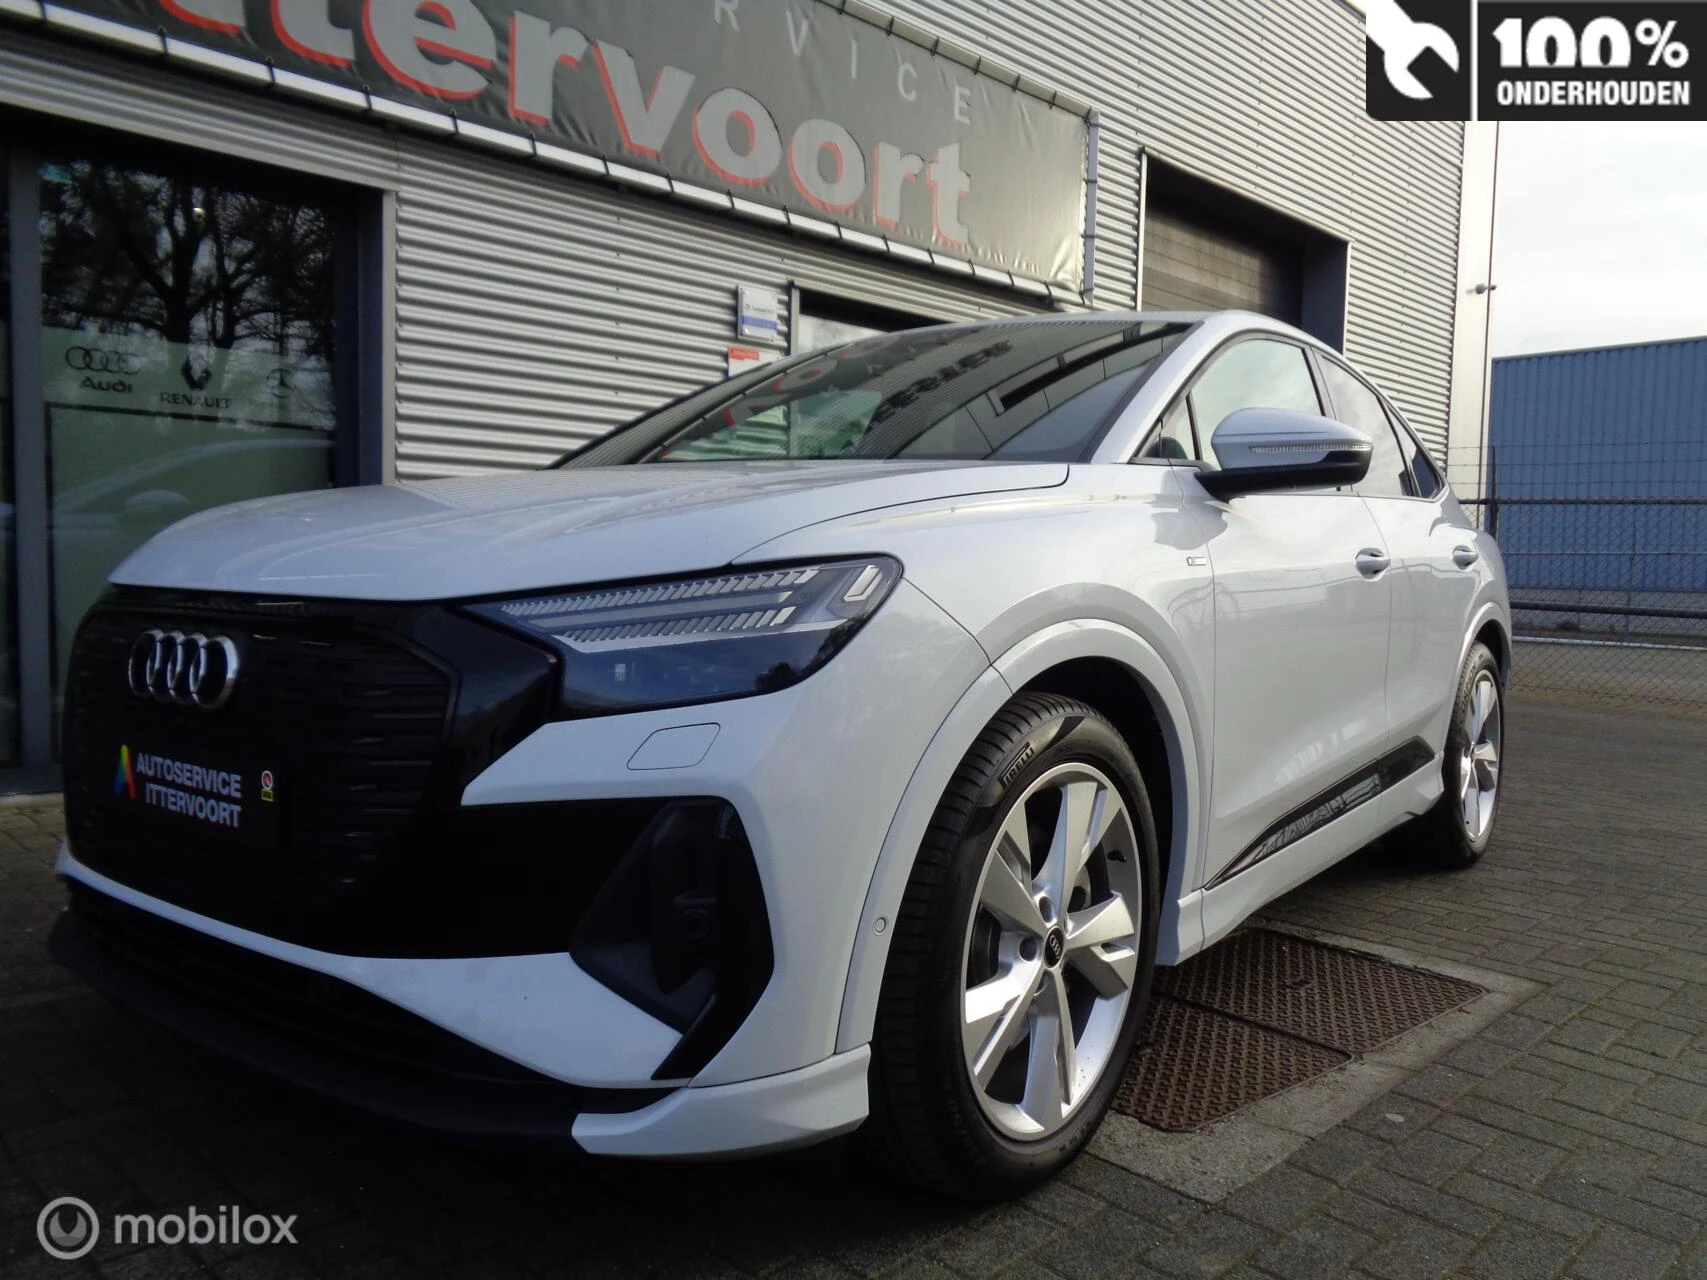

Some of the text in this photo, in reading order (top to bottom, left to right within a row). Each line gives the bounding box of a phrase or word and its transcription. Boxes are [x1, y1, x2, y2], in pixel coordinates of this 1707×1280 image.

[160, 0, 970, 249] ervoort
[80, 375, 132, 394] Audi
[136, 752, 242, 799] AUTOSERVICE
[145, 782, 242, 828] ITTERVOORT
